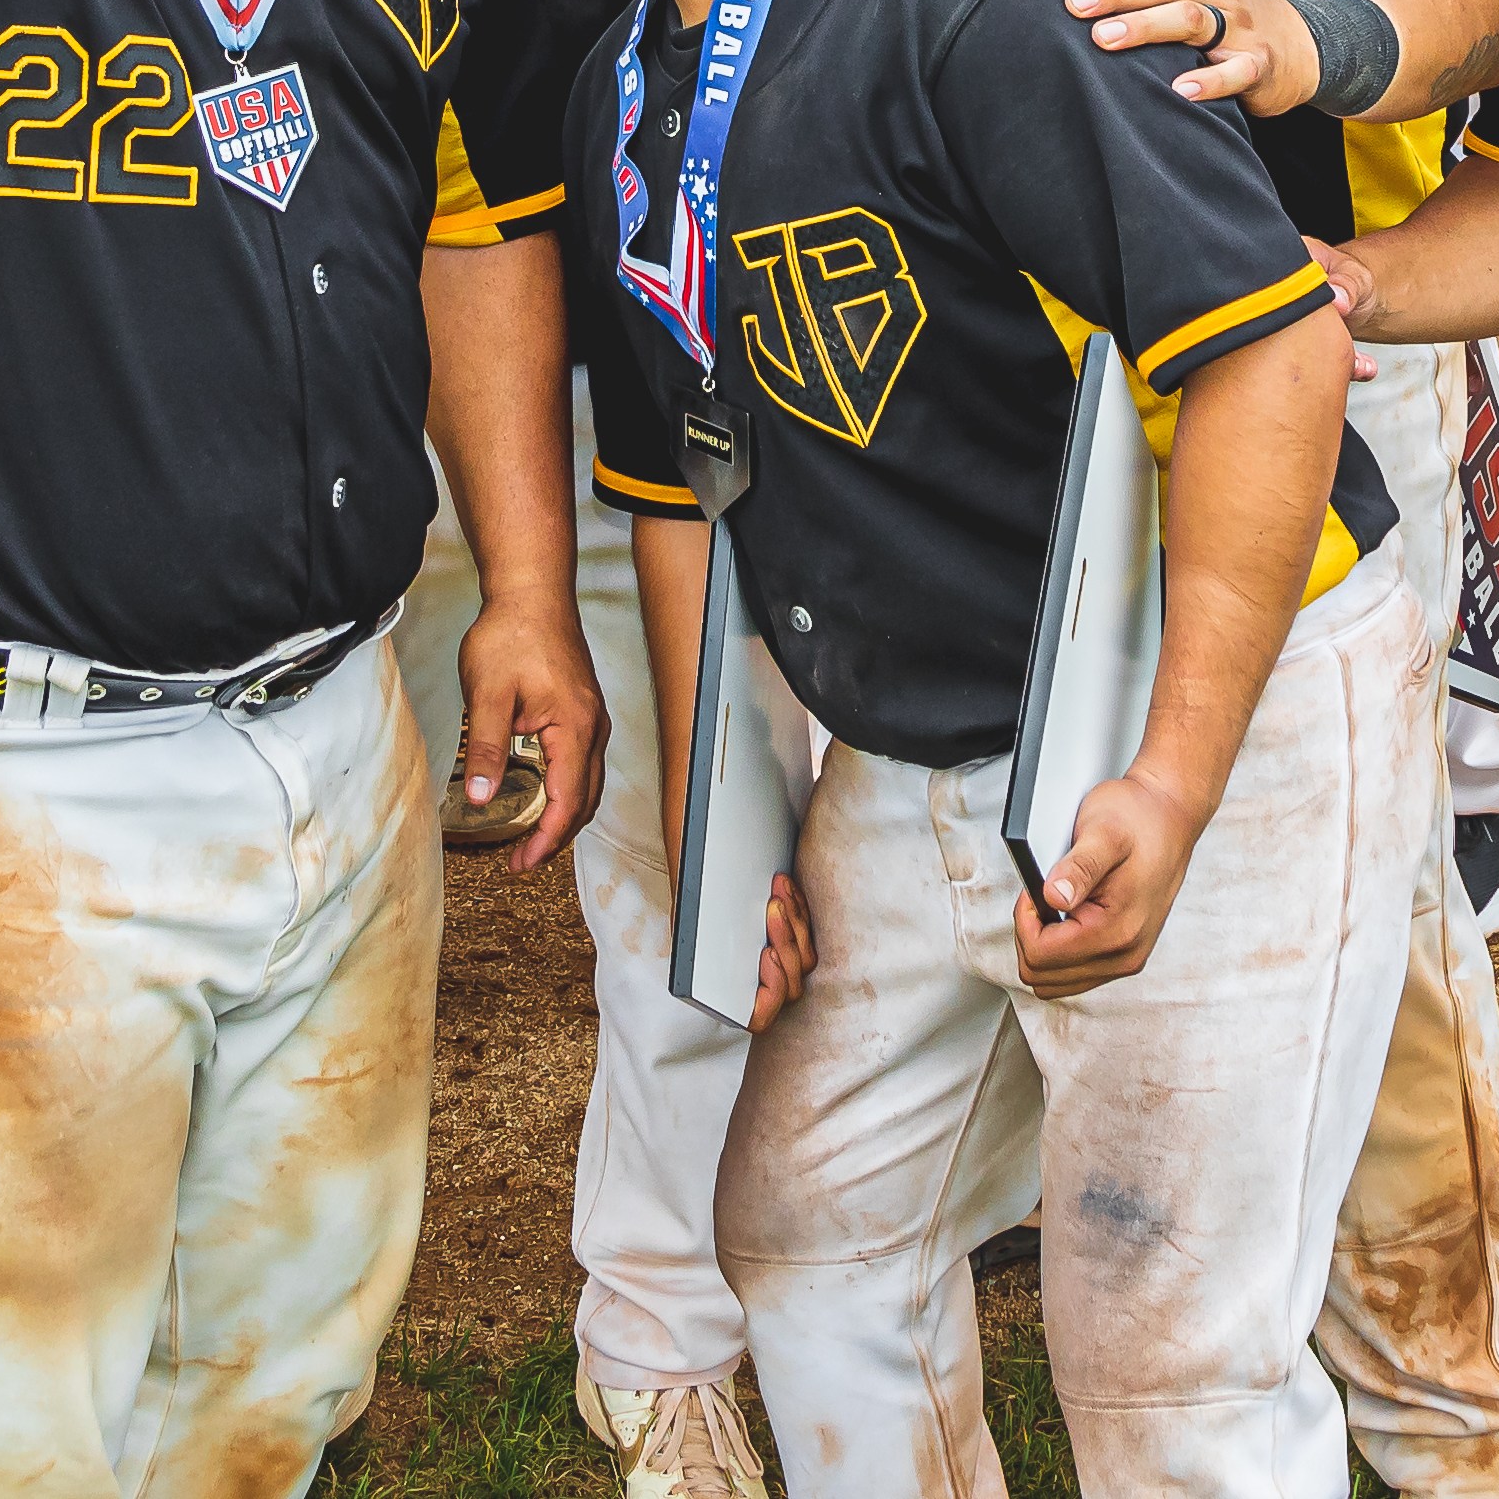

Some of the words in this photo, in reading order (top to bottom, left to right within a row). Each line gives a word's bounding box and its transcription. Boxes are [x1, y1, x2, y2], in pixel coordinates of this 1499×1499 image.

[202, 78, 303, 142] USA
[218, 118, 309, 163] SOFTBALL
[731, 206, 928, 449] JB
[687, 425, 718, 449] RUNNER
[719, 439, 731, 452] UP
